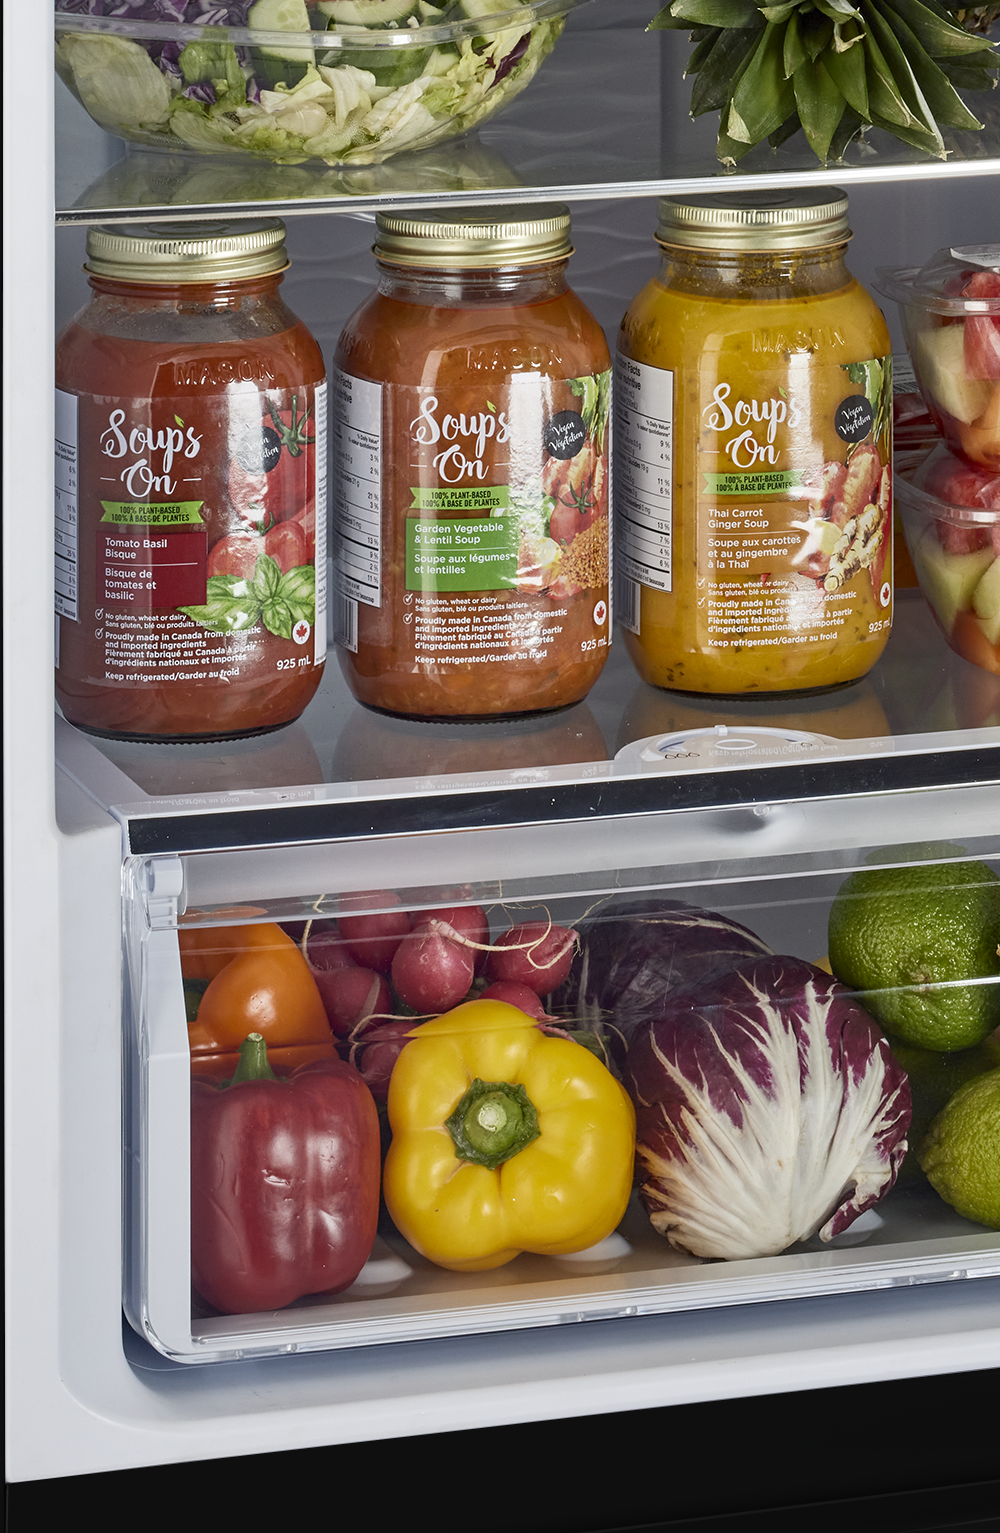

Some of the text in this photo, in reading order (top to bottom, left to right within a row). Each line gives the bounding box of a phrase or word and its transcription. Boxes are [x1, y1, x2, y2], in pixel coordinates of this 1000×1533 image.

[725, 430, 780, 468] On
[433, 444, 489, 483] On
[120, 458, 177, 497] On
[451, 491, 491, 499] PLANT-BASED
[441, 498, 446, 507] À
[447, 499, 462, 507] BASE
[474, 498, 500, 506] PLANTES
[708, 509, 763, 517] Thai Carrot
[415, 523, 503, 534] Garden Vegetable
[708, 520, 769, 529] Ginger Soup
[105, 537, 167, 548] Tomato Basil
[414, 535, 480, 544] & Lentil Soup
[708, 538, 739, 548] Soupe
[762, 536, 801, 546] carottes
[105, 549, 136, 559] Bisque
[414, 554, 445, 564] Soupe
[469, 553, 510, 563] légumes
[736, 548, 788, 559] gingembre
[708, 560, 749, 568] à la Thaï
[105, 568, 152, 578] Bisque de
[427, 566, 466, 574] lentilles
[105, 580, 157, 589] tomates et
[105, 590, 134, 600] basilic
[276, 656, 311, 670] 925 mL
